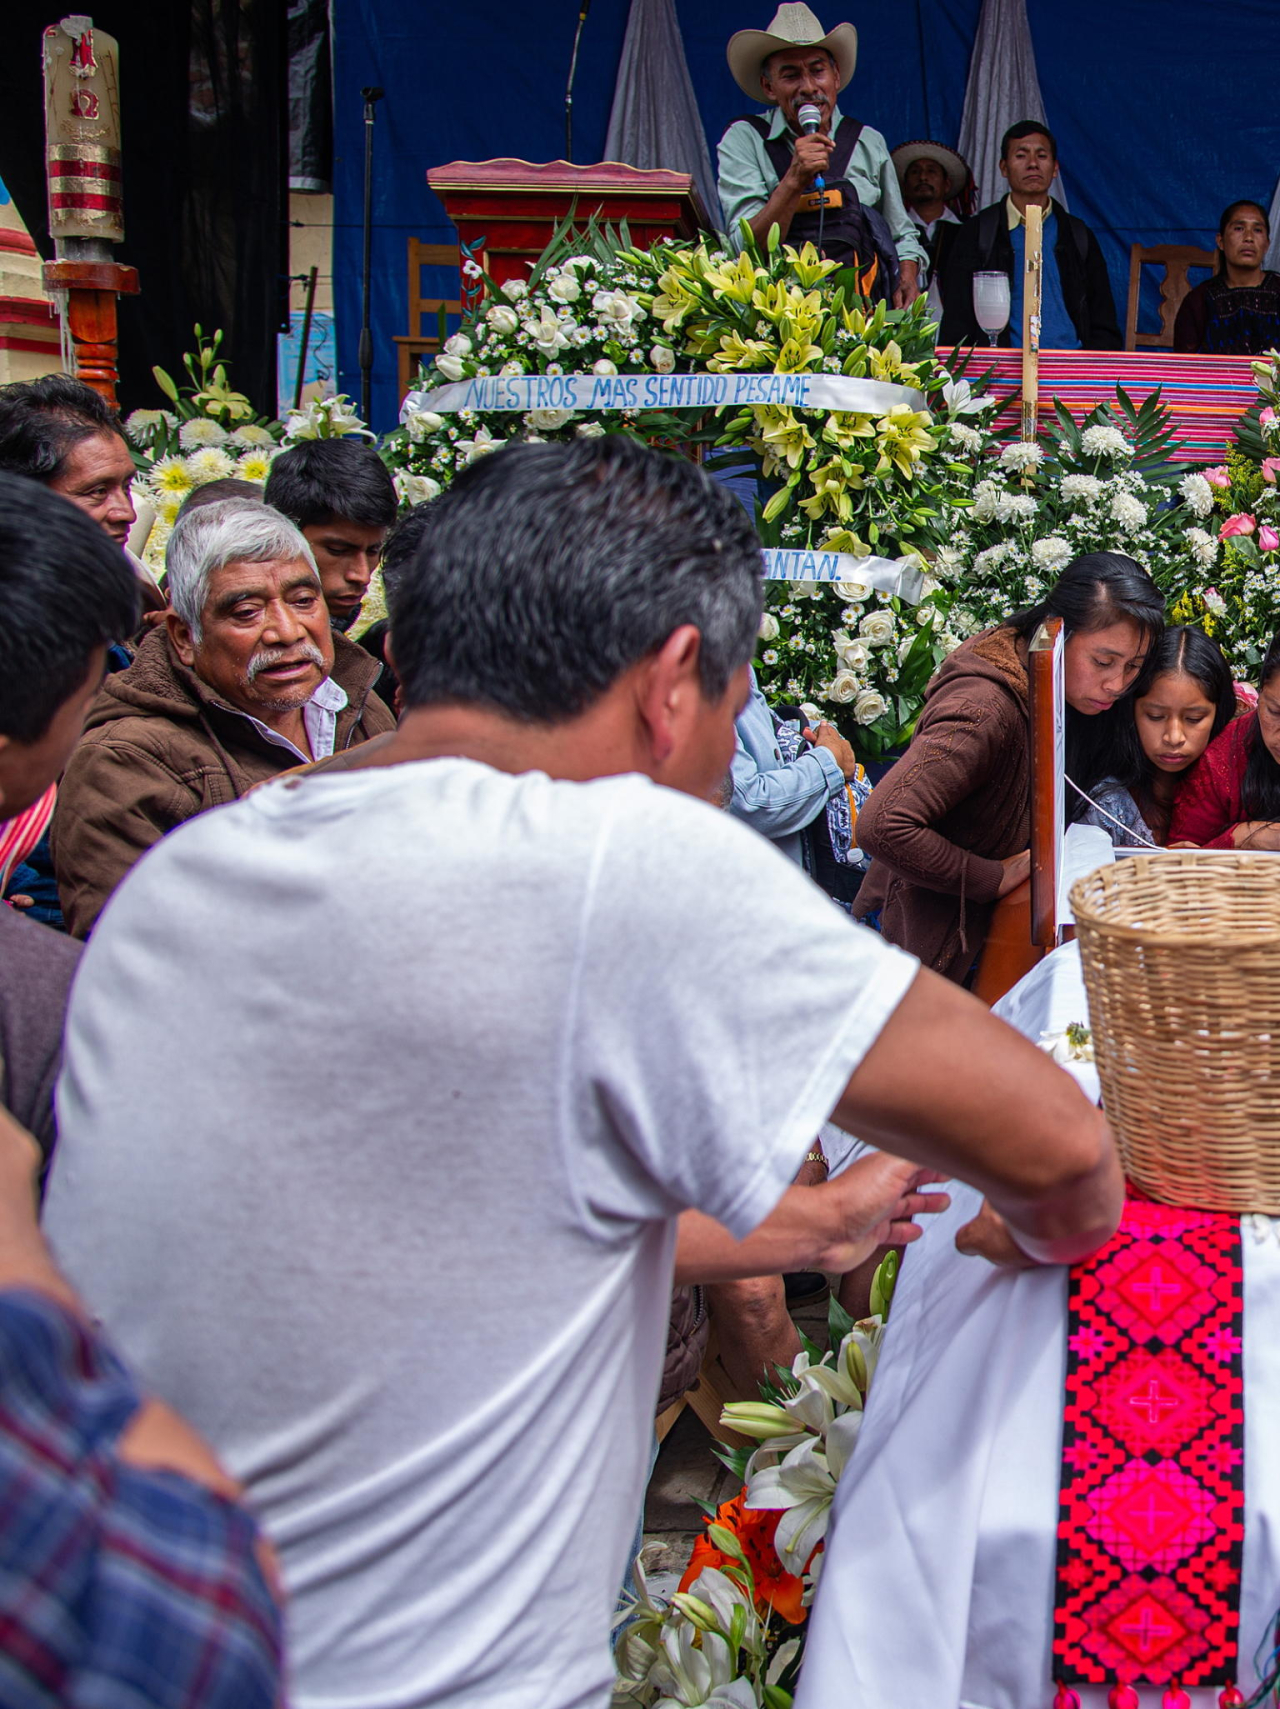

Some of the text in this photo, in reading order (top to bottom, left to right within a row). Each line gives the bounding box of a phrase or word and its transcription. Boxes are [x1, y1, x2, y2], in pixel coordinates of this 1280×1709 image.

[464, 374, 812, 410] NUESTROS MAS SENTIDO PESAME
